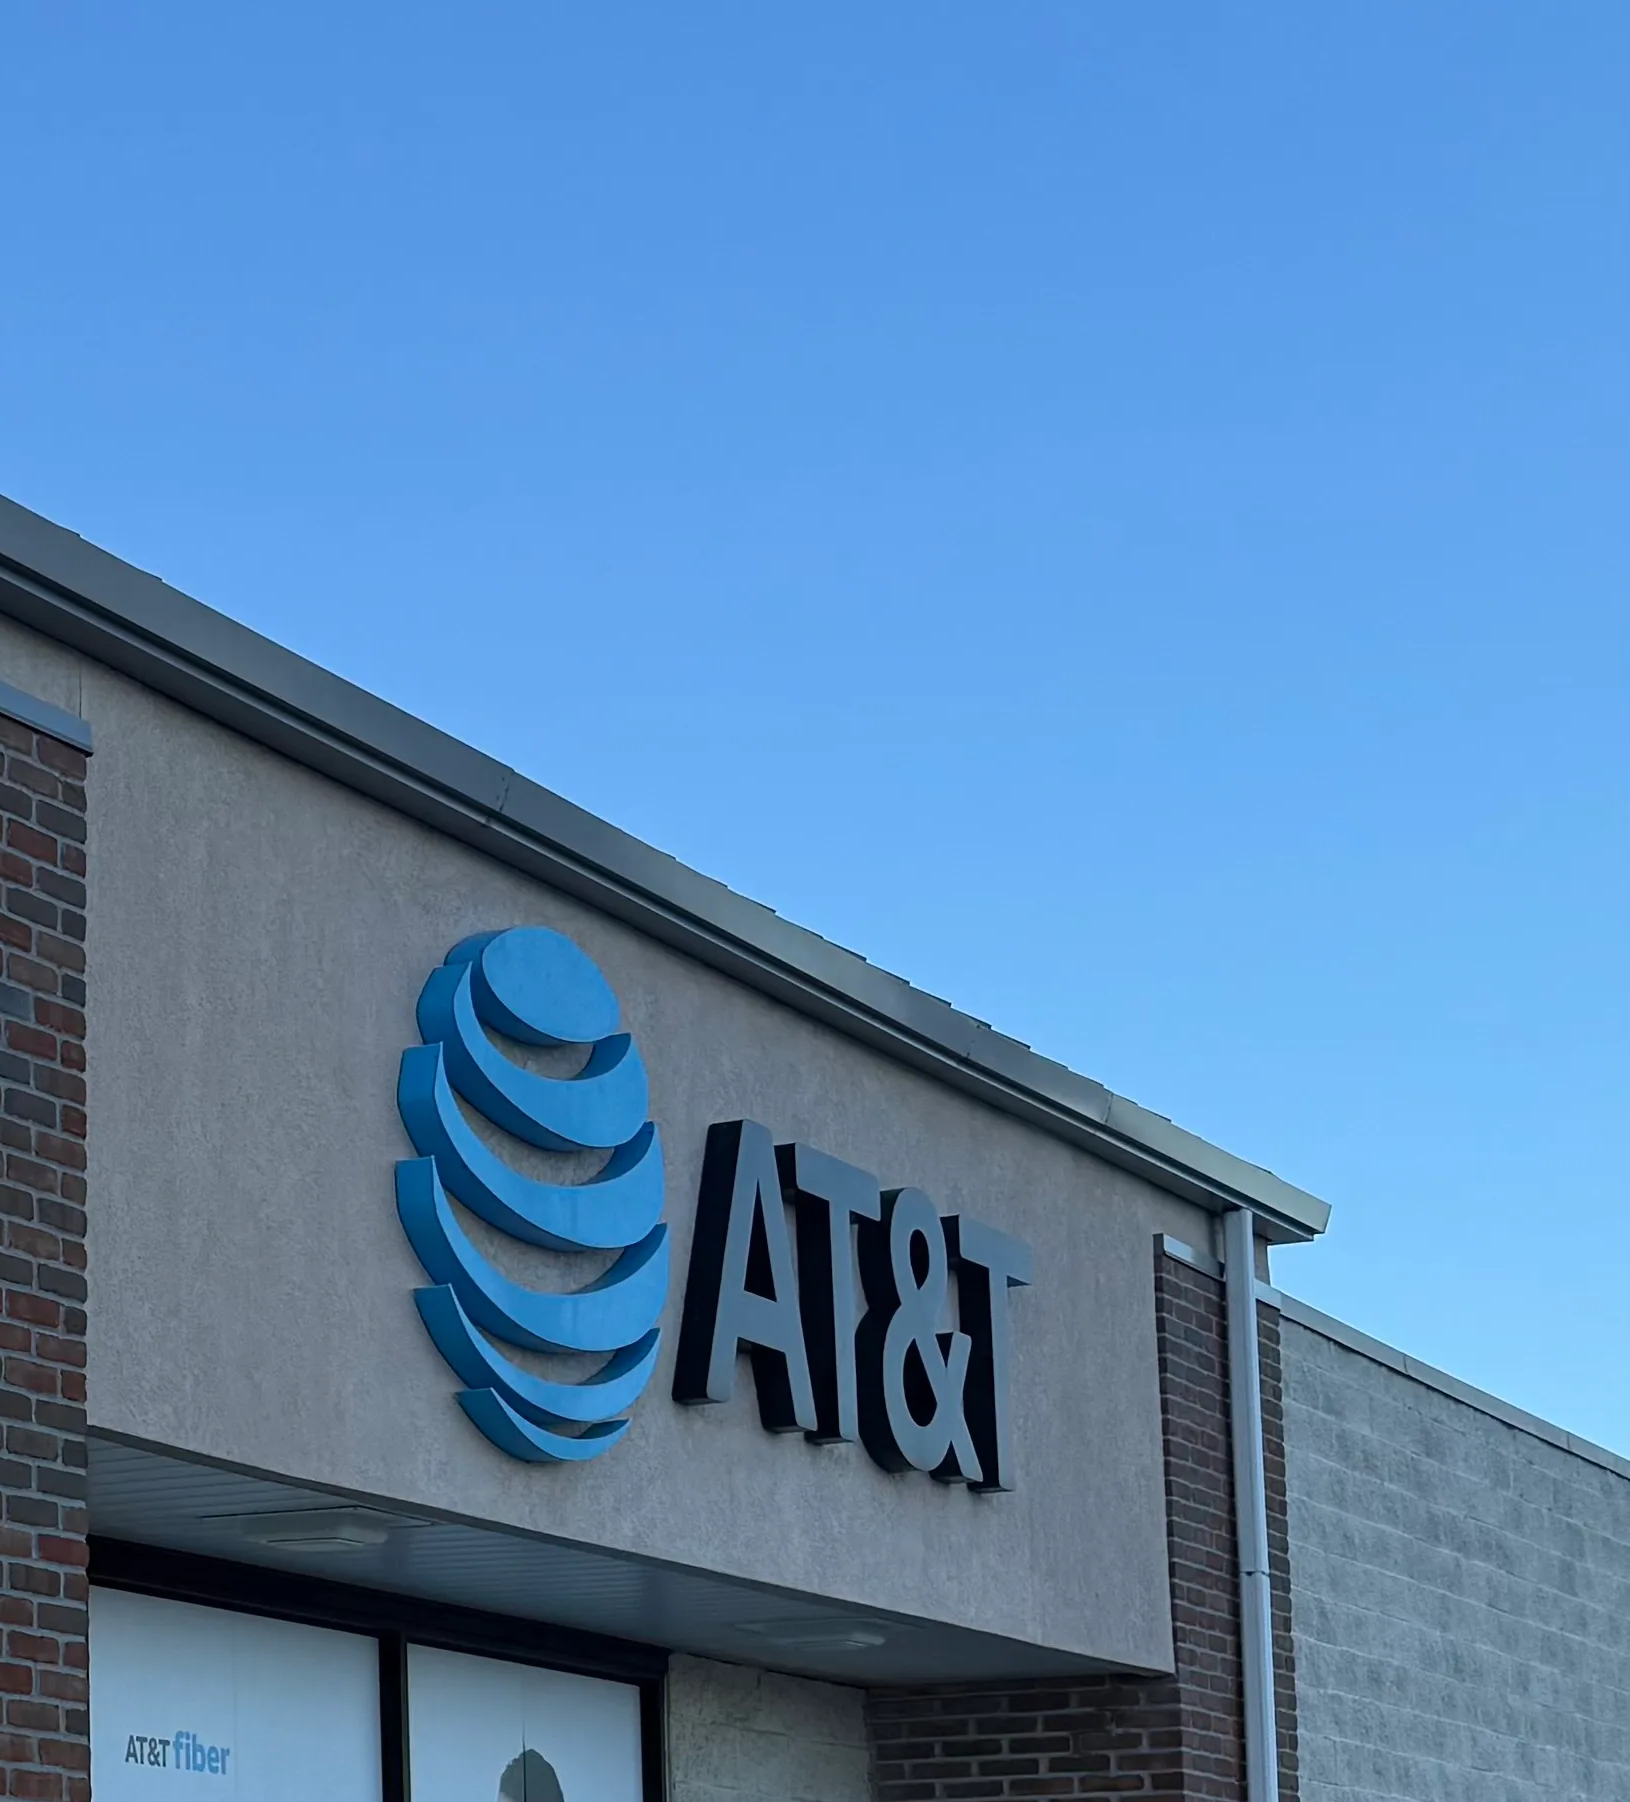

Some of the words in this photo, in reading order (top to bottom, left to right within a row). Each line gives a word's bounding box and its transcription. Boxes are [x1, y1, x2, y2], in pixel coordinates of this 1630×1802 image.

[671, 1119, 1031, 1494] AT&T
[124, 1734, 171, 1768] AT&T
[172, 1730, 231, 1775] fiber
